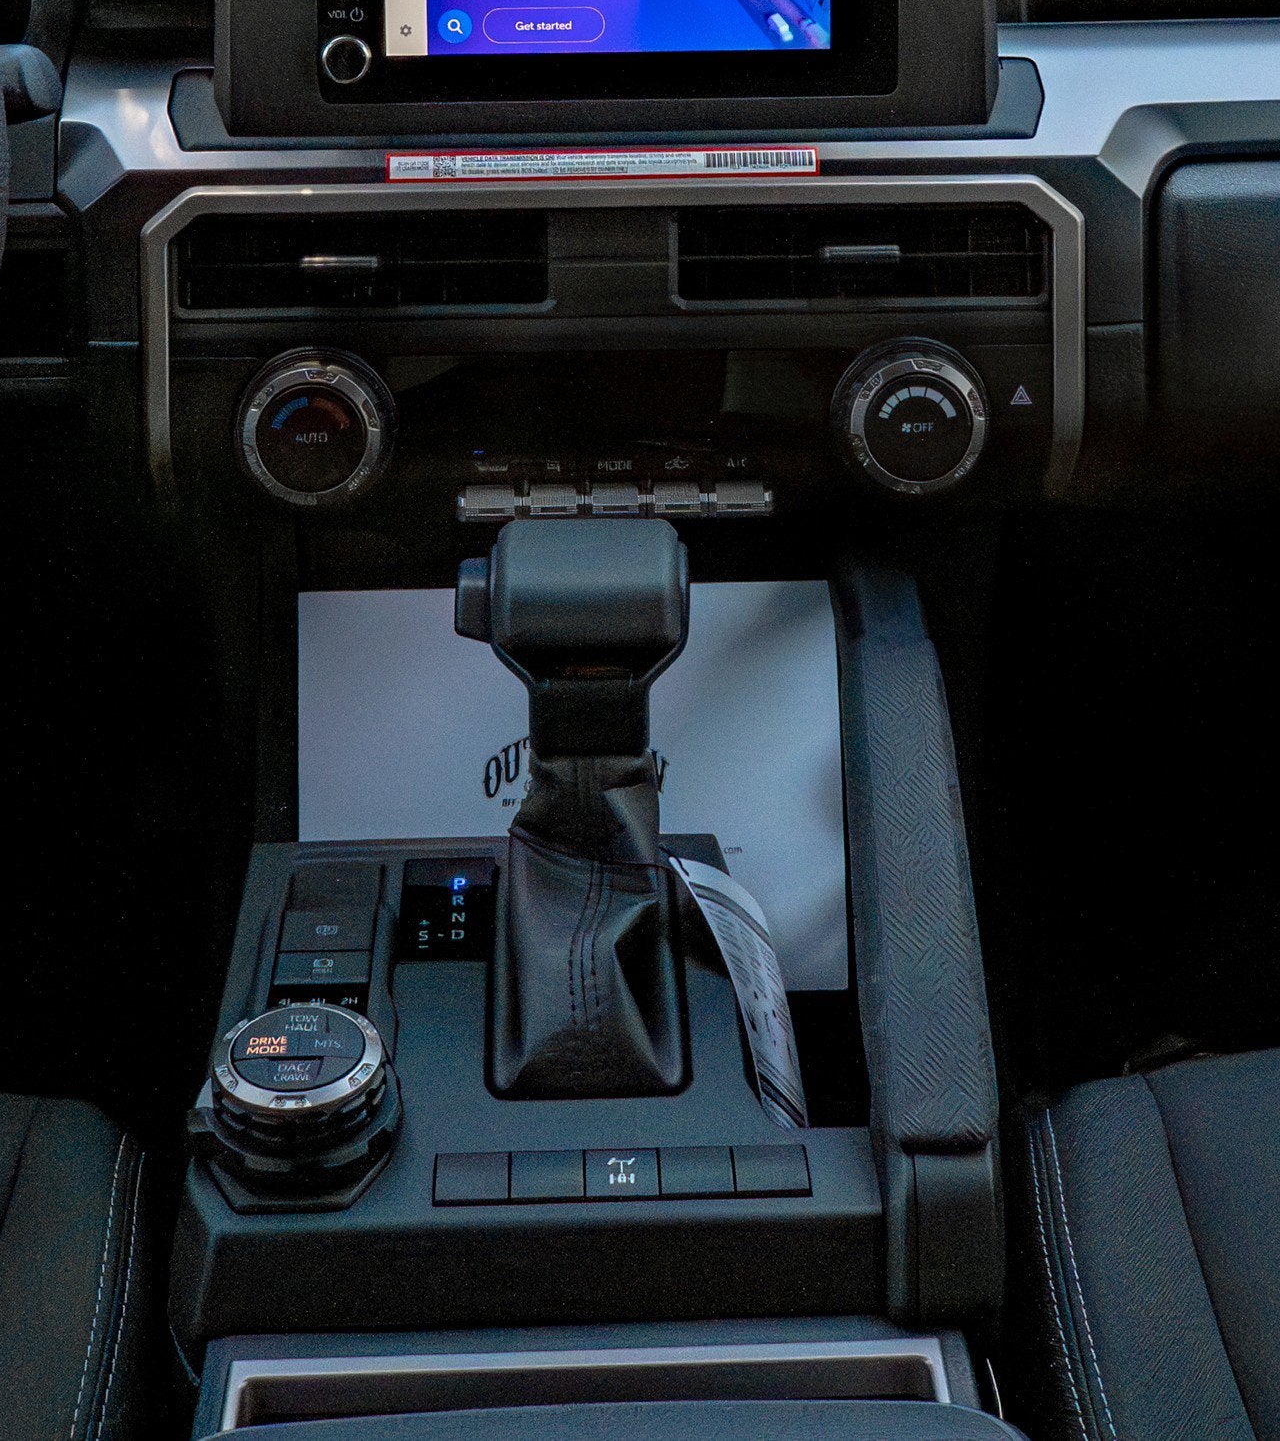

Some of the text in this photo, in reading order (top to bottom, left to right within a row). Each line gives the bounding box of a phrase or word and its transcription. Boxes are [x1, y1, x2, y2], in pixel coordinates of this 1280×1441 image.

[327, 10, 348, 19] VOL
[515, 20, 572, 31] Get started
[913, 422, 934, 433] OFF
[295, 432, 328, 444] AUTO
[598, 460, 632, 471] MODE
[453, 877, 466, 890] P
[452, 895, 465, 906] R
[451, 912, 466, 923] N
[418, 929, 465, 941] S D
[340, 997, 358, 1005] 2H
[285, 1023, 318, 1032] HAUL
[249, 1035, 288, 1045] DRIVE
[314, 1039, 341, 1049] MTS
[246, 1045, 288, 1055] MODE
[273, 1073, 310, 1082] CRAWL
